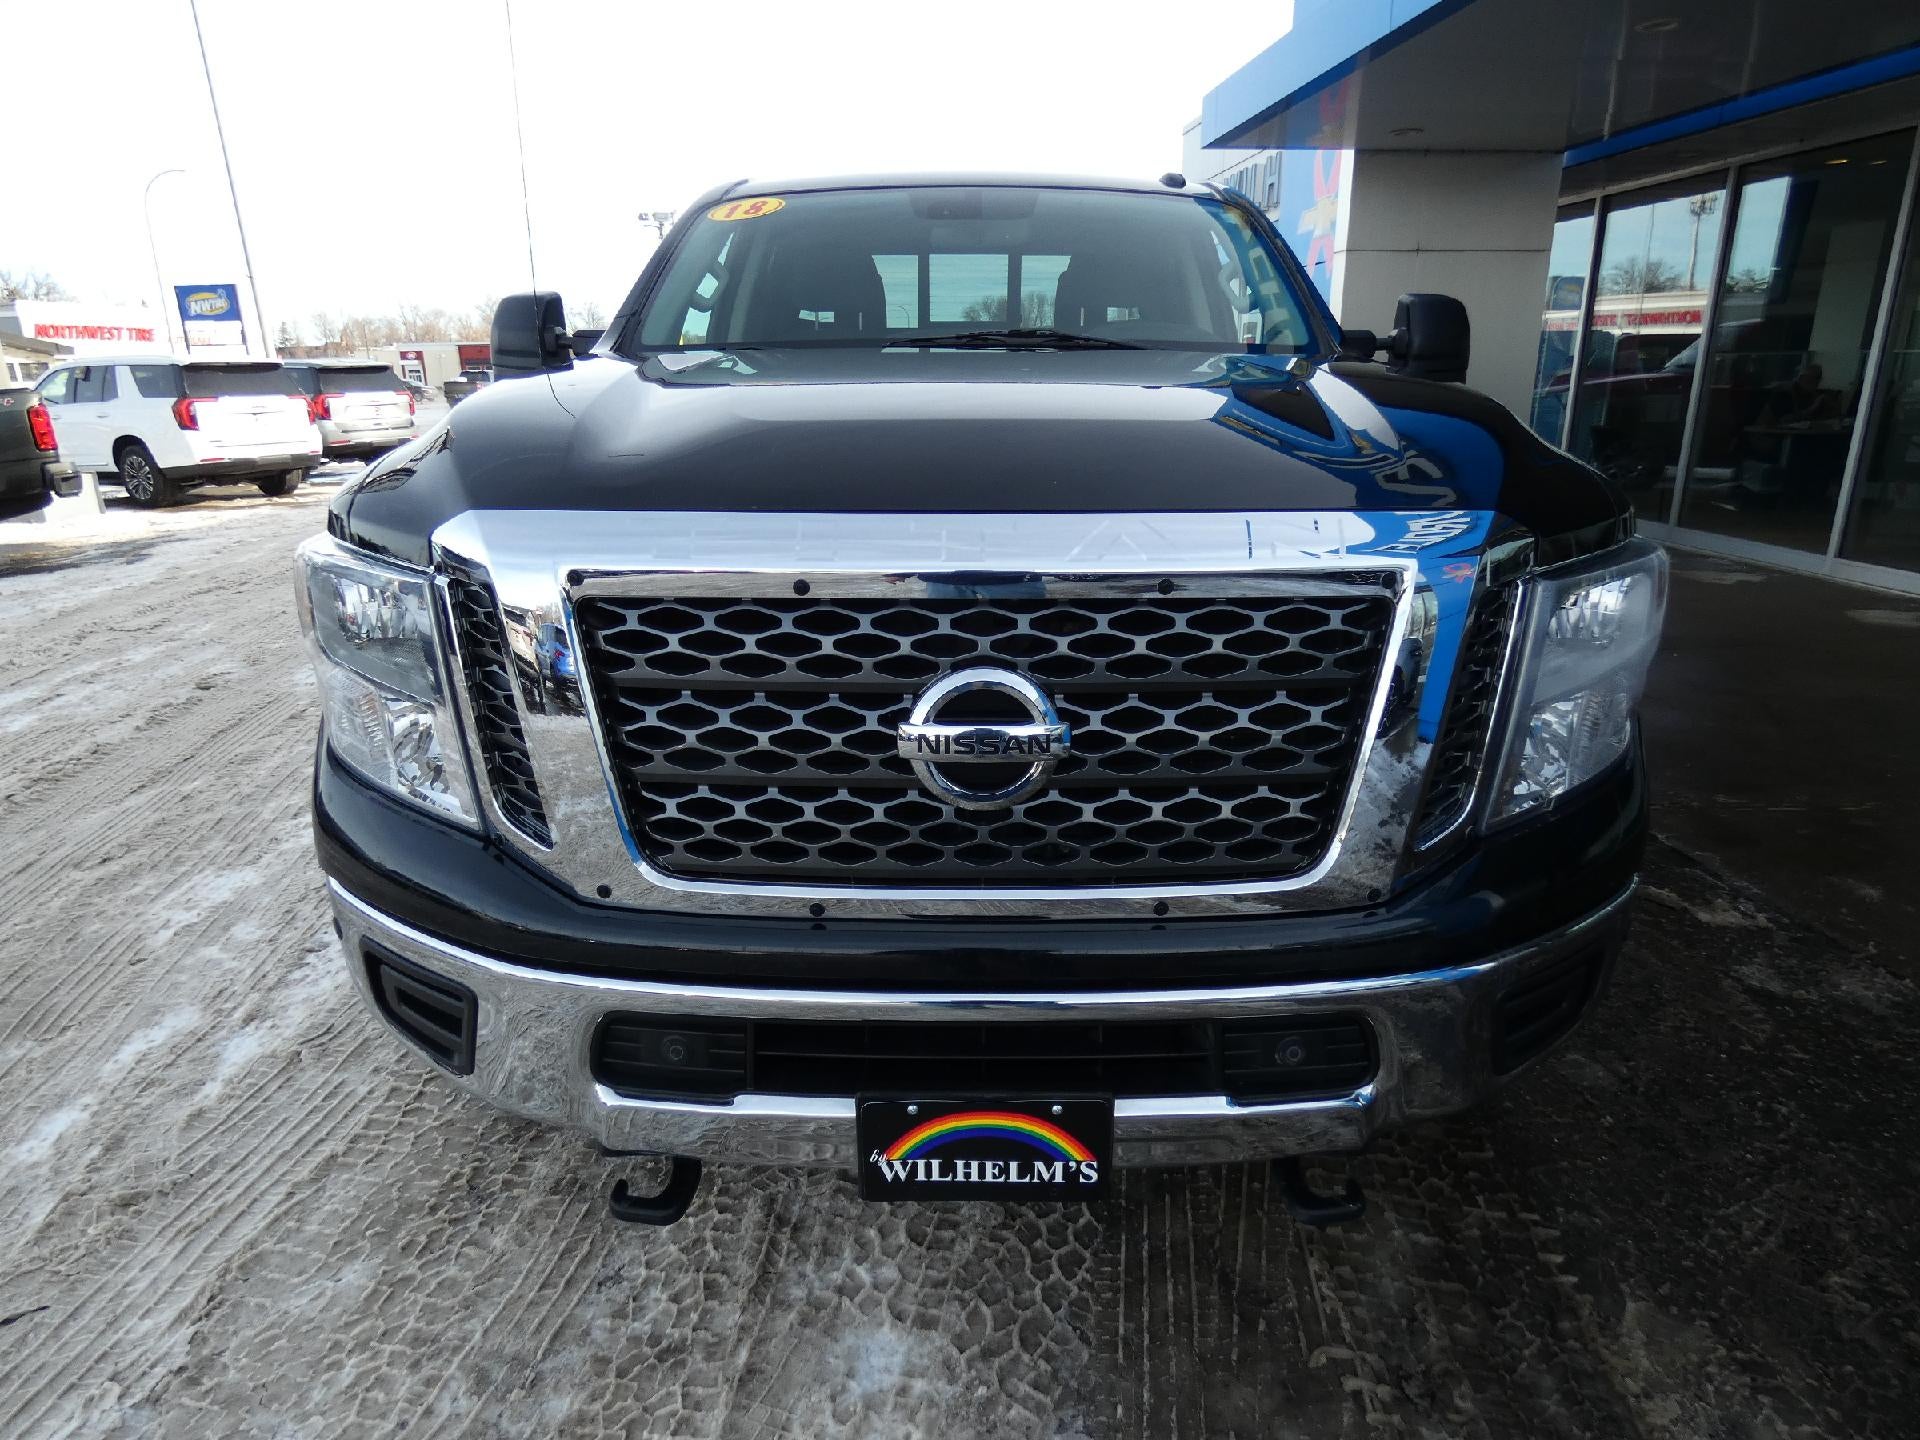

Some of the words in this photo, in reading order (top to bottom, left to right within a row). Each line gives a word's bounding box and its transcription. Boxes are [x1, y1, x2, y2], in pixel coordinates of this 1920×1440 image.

[725, 201, 768, 218] 18
[34, 323, 124, 341] NORTHWEST
[127, 327, 156, 343] TIRE
[917, 733, 1050, 755] NISSAN
[870, 1149, 888, 1165] by
[880, 1159, 1099, 1184] WILHELM'S
